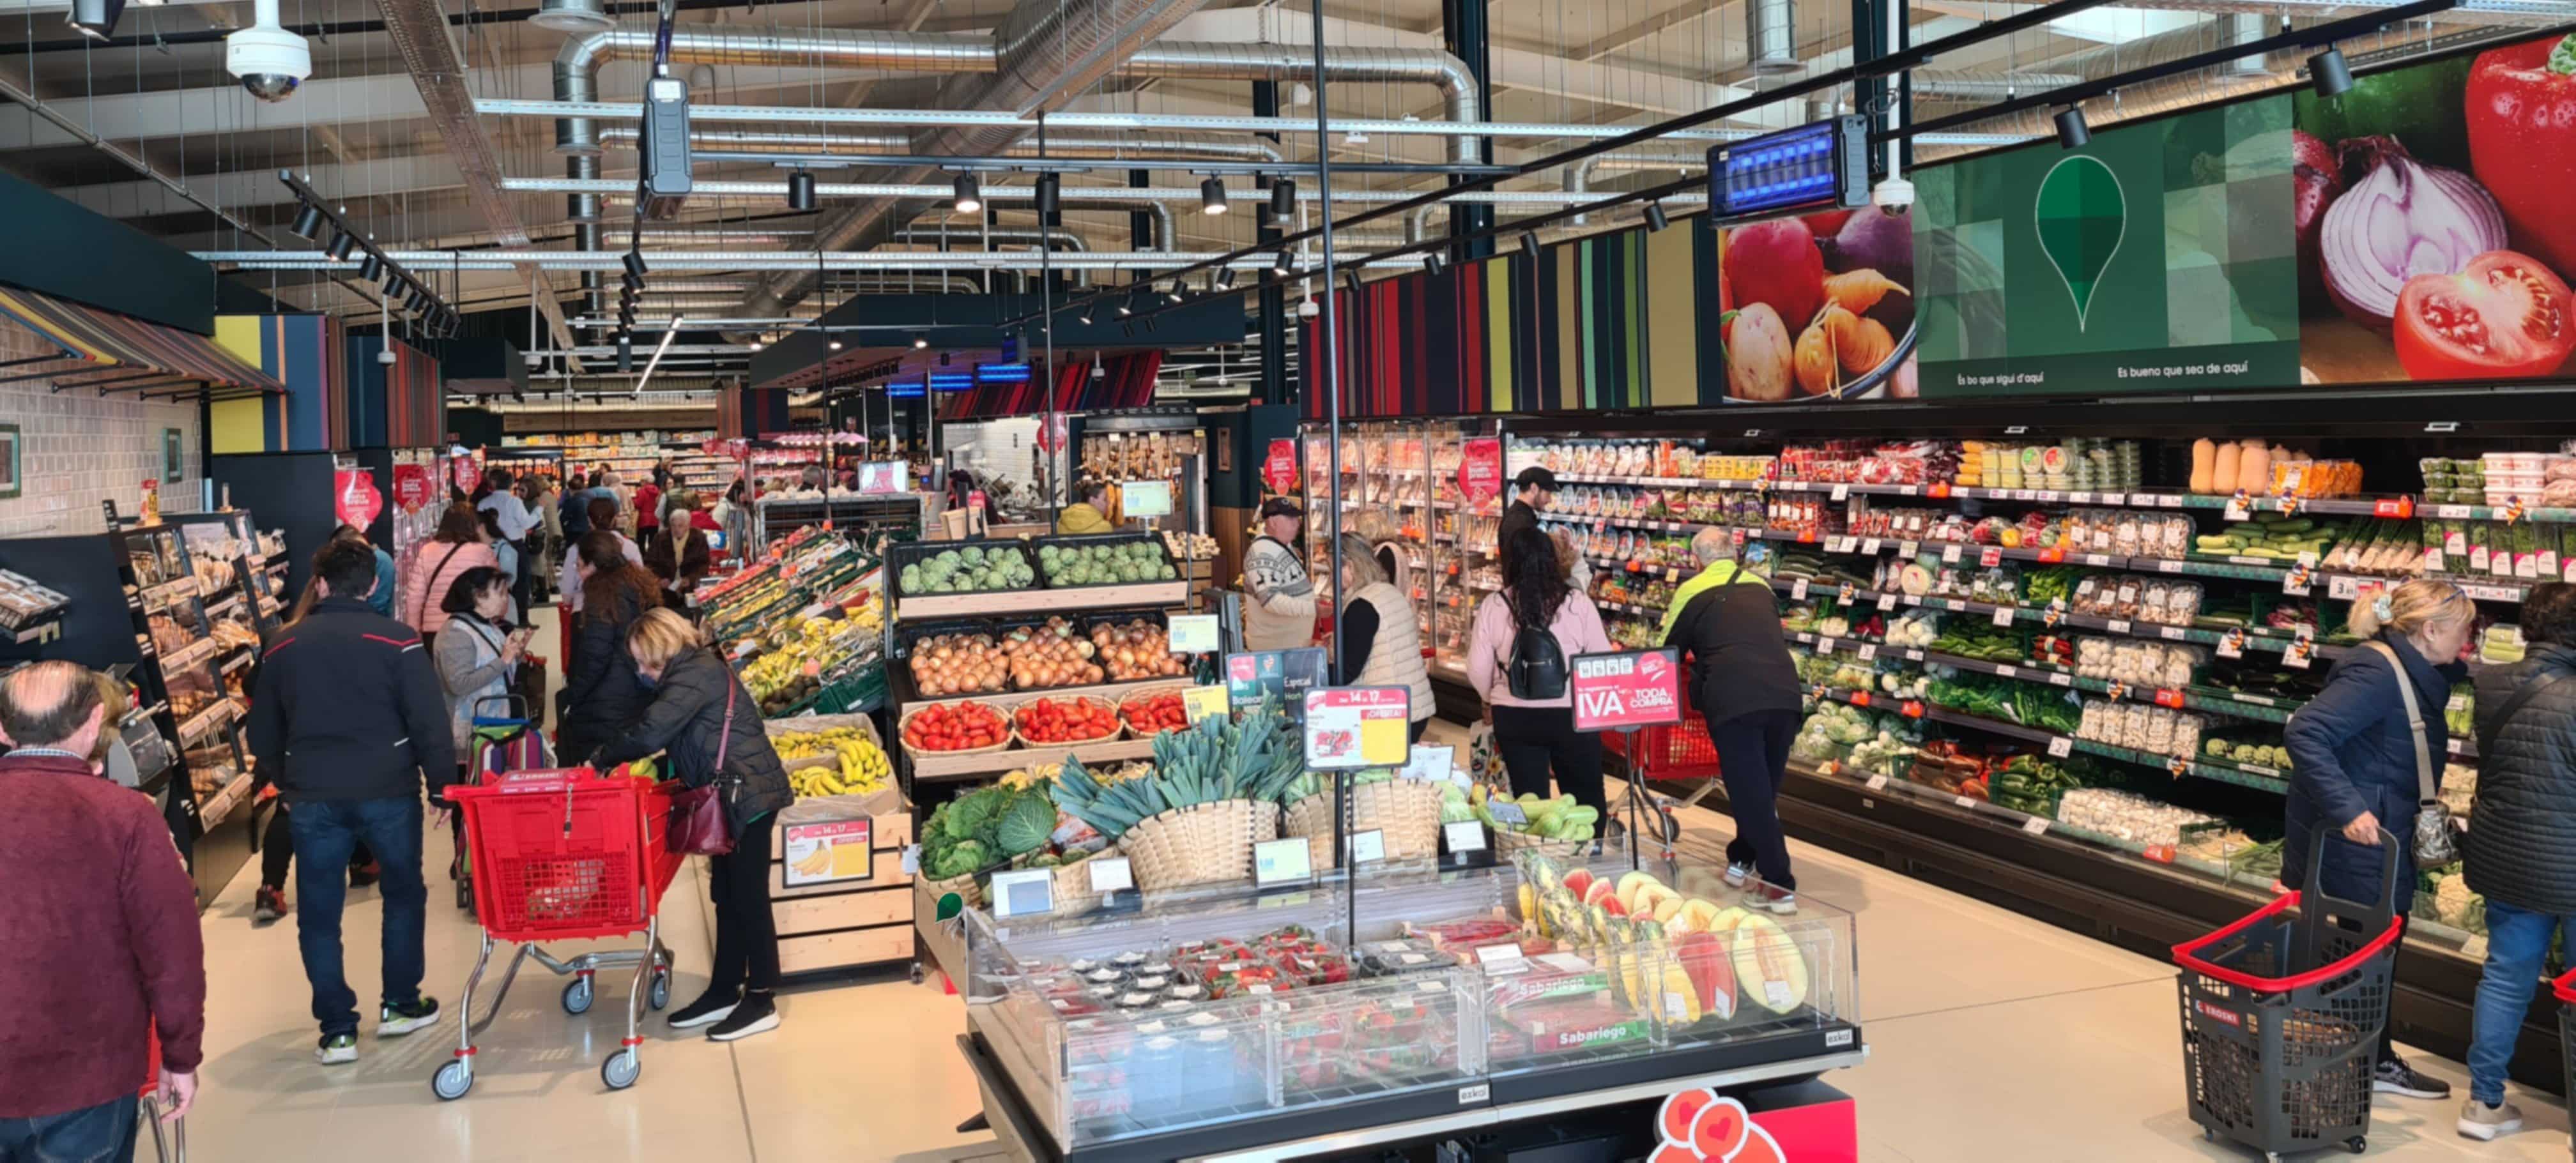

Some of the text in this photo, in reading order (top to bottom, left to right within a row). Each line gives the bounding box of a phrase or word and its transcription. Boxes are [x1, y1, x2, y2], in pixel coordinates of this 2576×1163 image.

[2117, 360, 2248, 378] Es bueno que sea de aquí
[1967, 375, 1978, 384] bo
[1979, 376, 1995, 386] que
[1996, 374, 2015, 386] sigui
[1350, 691, 1361, 703] 14
[1369, 690, 1380, 703] 17
[1636, 687, 1667, 698] TODA
[1579, 691, 1625, 718] IVA
[1630, 696, 1673, 708] COMPRA
[823, 826, 831, 834] 14
[838, 824, 846, 833] 17
[1519, 978, 1585, 995] Sabariego
[1560, 1026, 1627, 1045] Sabariego
